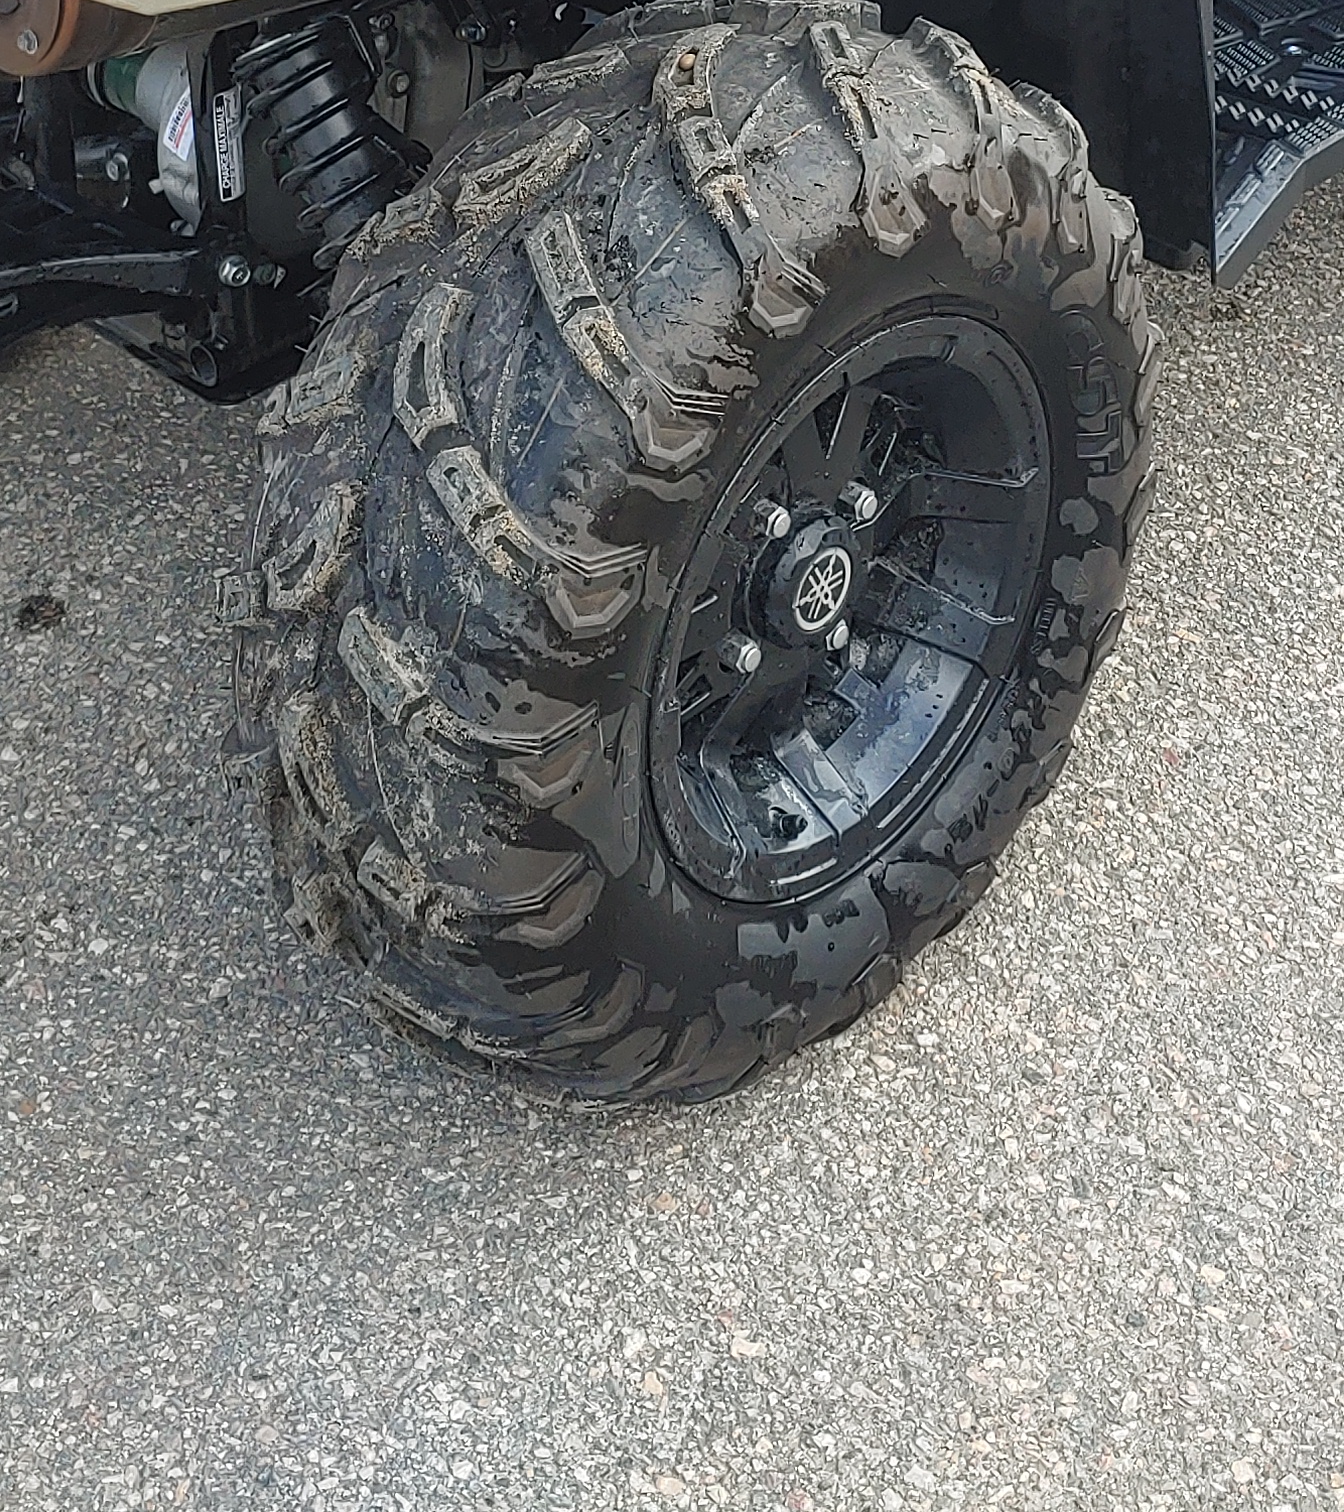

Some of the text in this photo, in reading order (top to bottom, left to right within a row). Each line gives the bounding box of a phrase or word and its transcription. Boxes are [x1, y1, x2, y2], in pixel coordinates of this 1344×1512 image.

[216, 105, 231, 189] CHARGE MAXIMALE
[1057, 308, 1123, 477] CST
